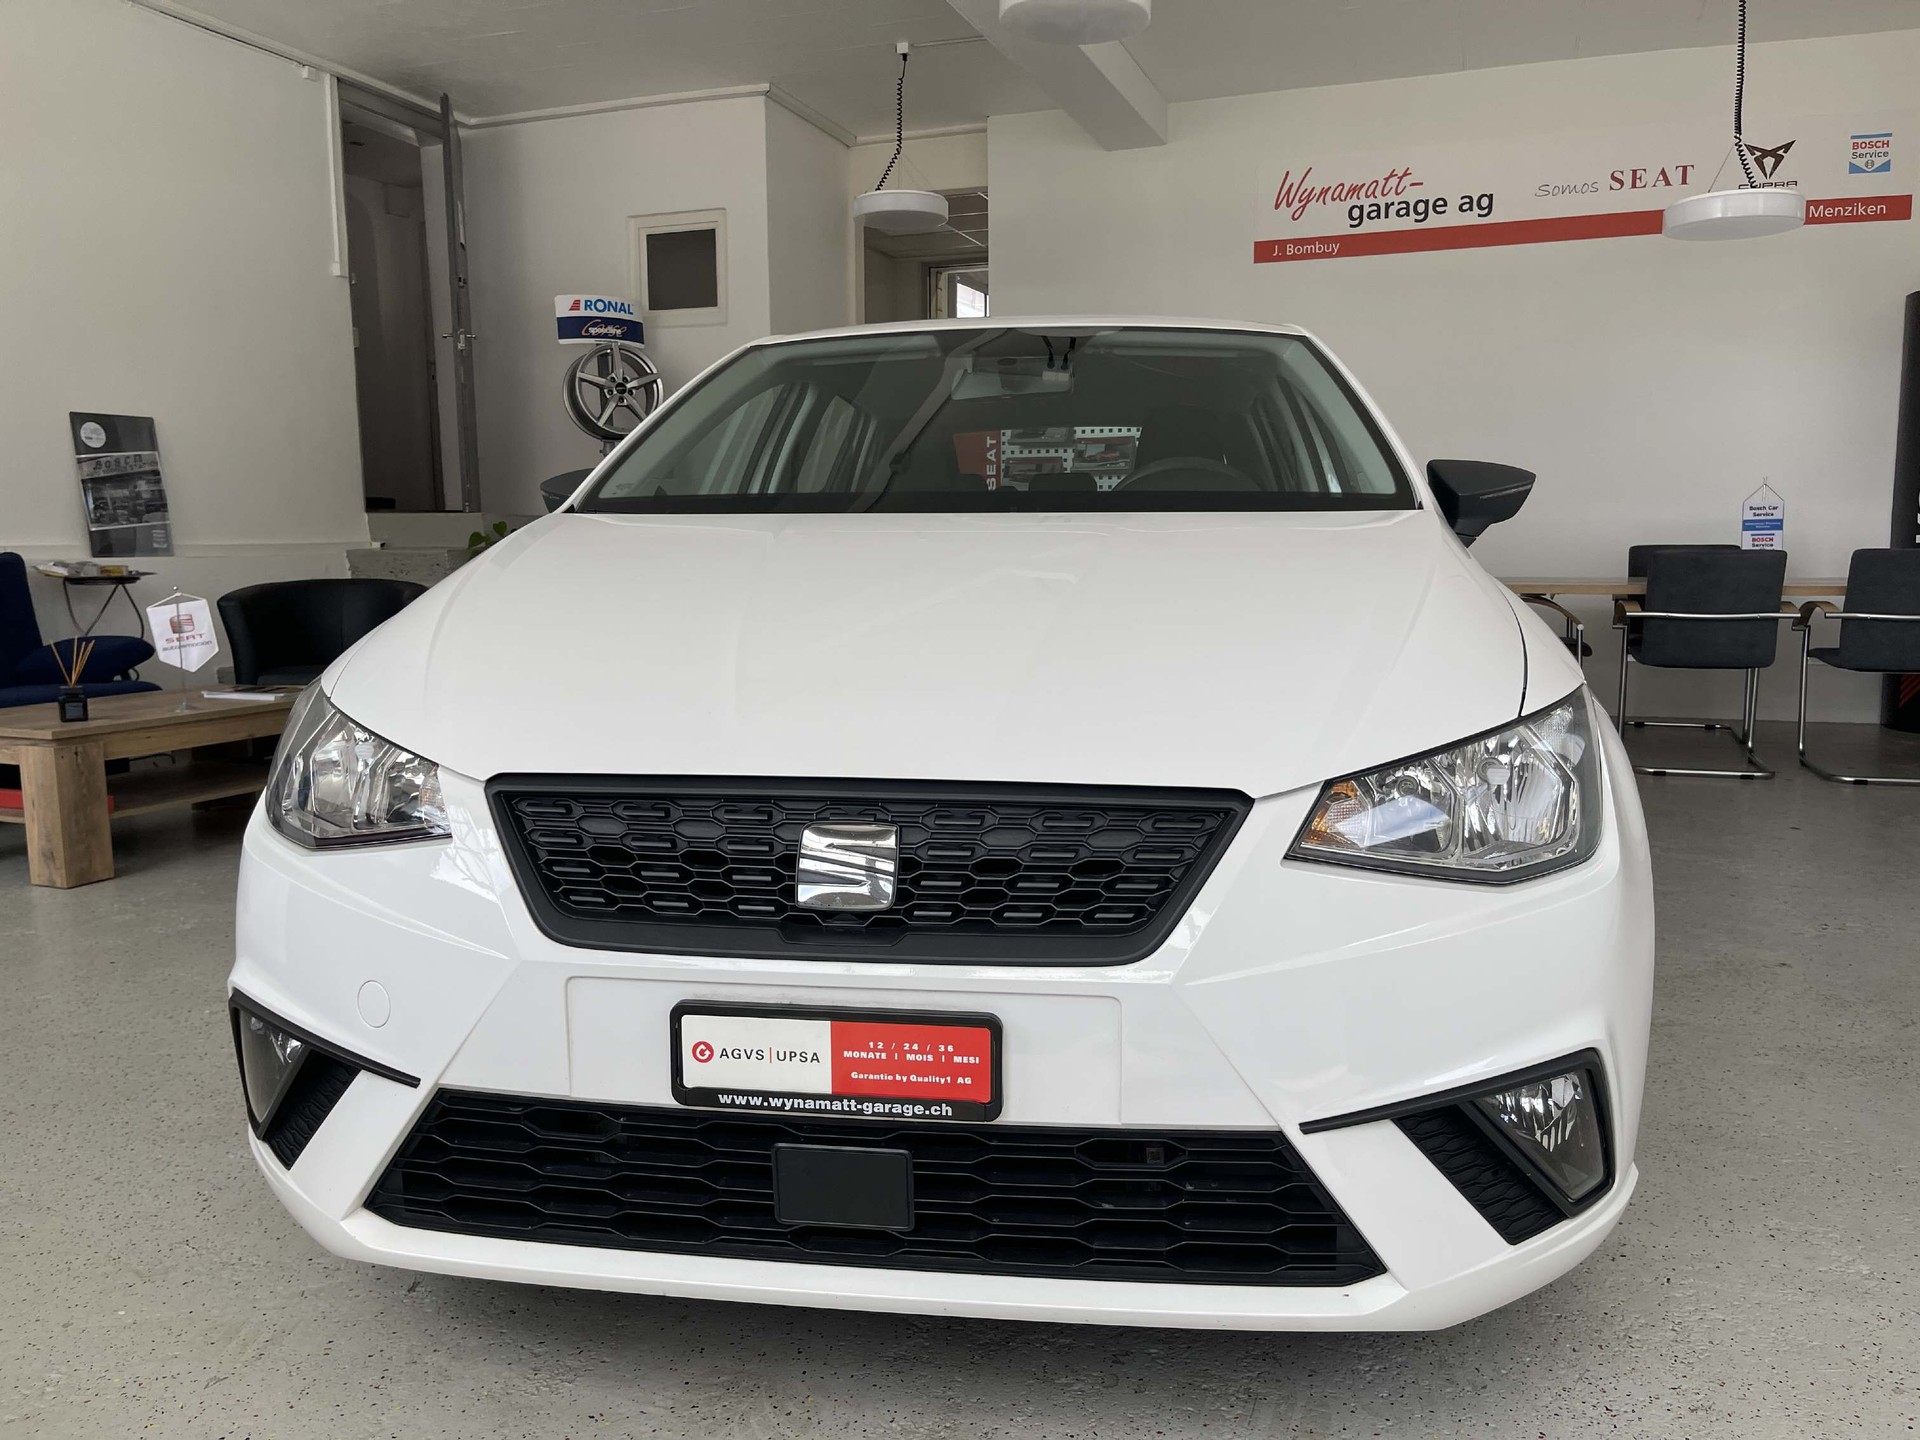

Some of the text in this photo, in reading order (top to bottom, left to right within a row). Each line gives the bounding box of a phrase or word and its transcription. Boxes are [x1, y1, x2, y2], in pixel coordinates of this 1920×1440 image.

[1852, 140, 1890, 150] BOSCH
[1851, 150, 1889, 160] Service
[1534, 165, 1695, 198] Somos SEAT
[1274, 167, 1424, 221] Wynamatt-
[1347, 192, 1494, 228] garage ag
[1808, 203, 1886, 218] Menziken
[1272, 242, 1340, 257] J. Bombuy
[584, 299, 633, 315] RONAL
[986, 436, 997, 491] SEAT
[165, 633, 206, 644] SEAT
[868, 1041, 884, 1050] 12
[903, 1043, 919, 1051] 24
[719, 1047, 821, 1063] AGVS UPSA
[843, 1051, 887, 1060] MONATE
[906, 1053, 934, 1062] MOIS
[953, 1056, 980, 1064] MESI
[851, 1072, 972, 1085] Garantie by Quality1 AG
[718, 1093, 952, 1116] www.wynamatt-garage.ch
